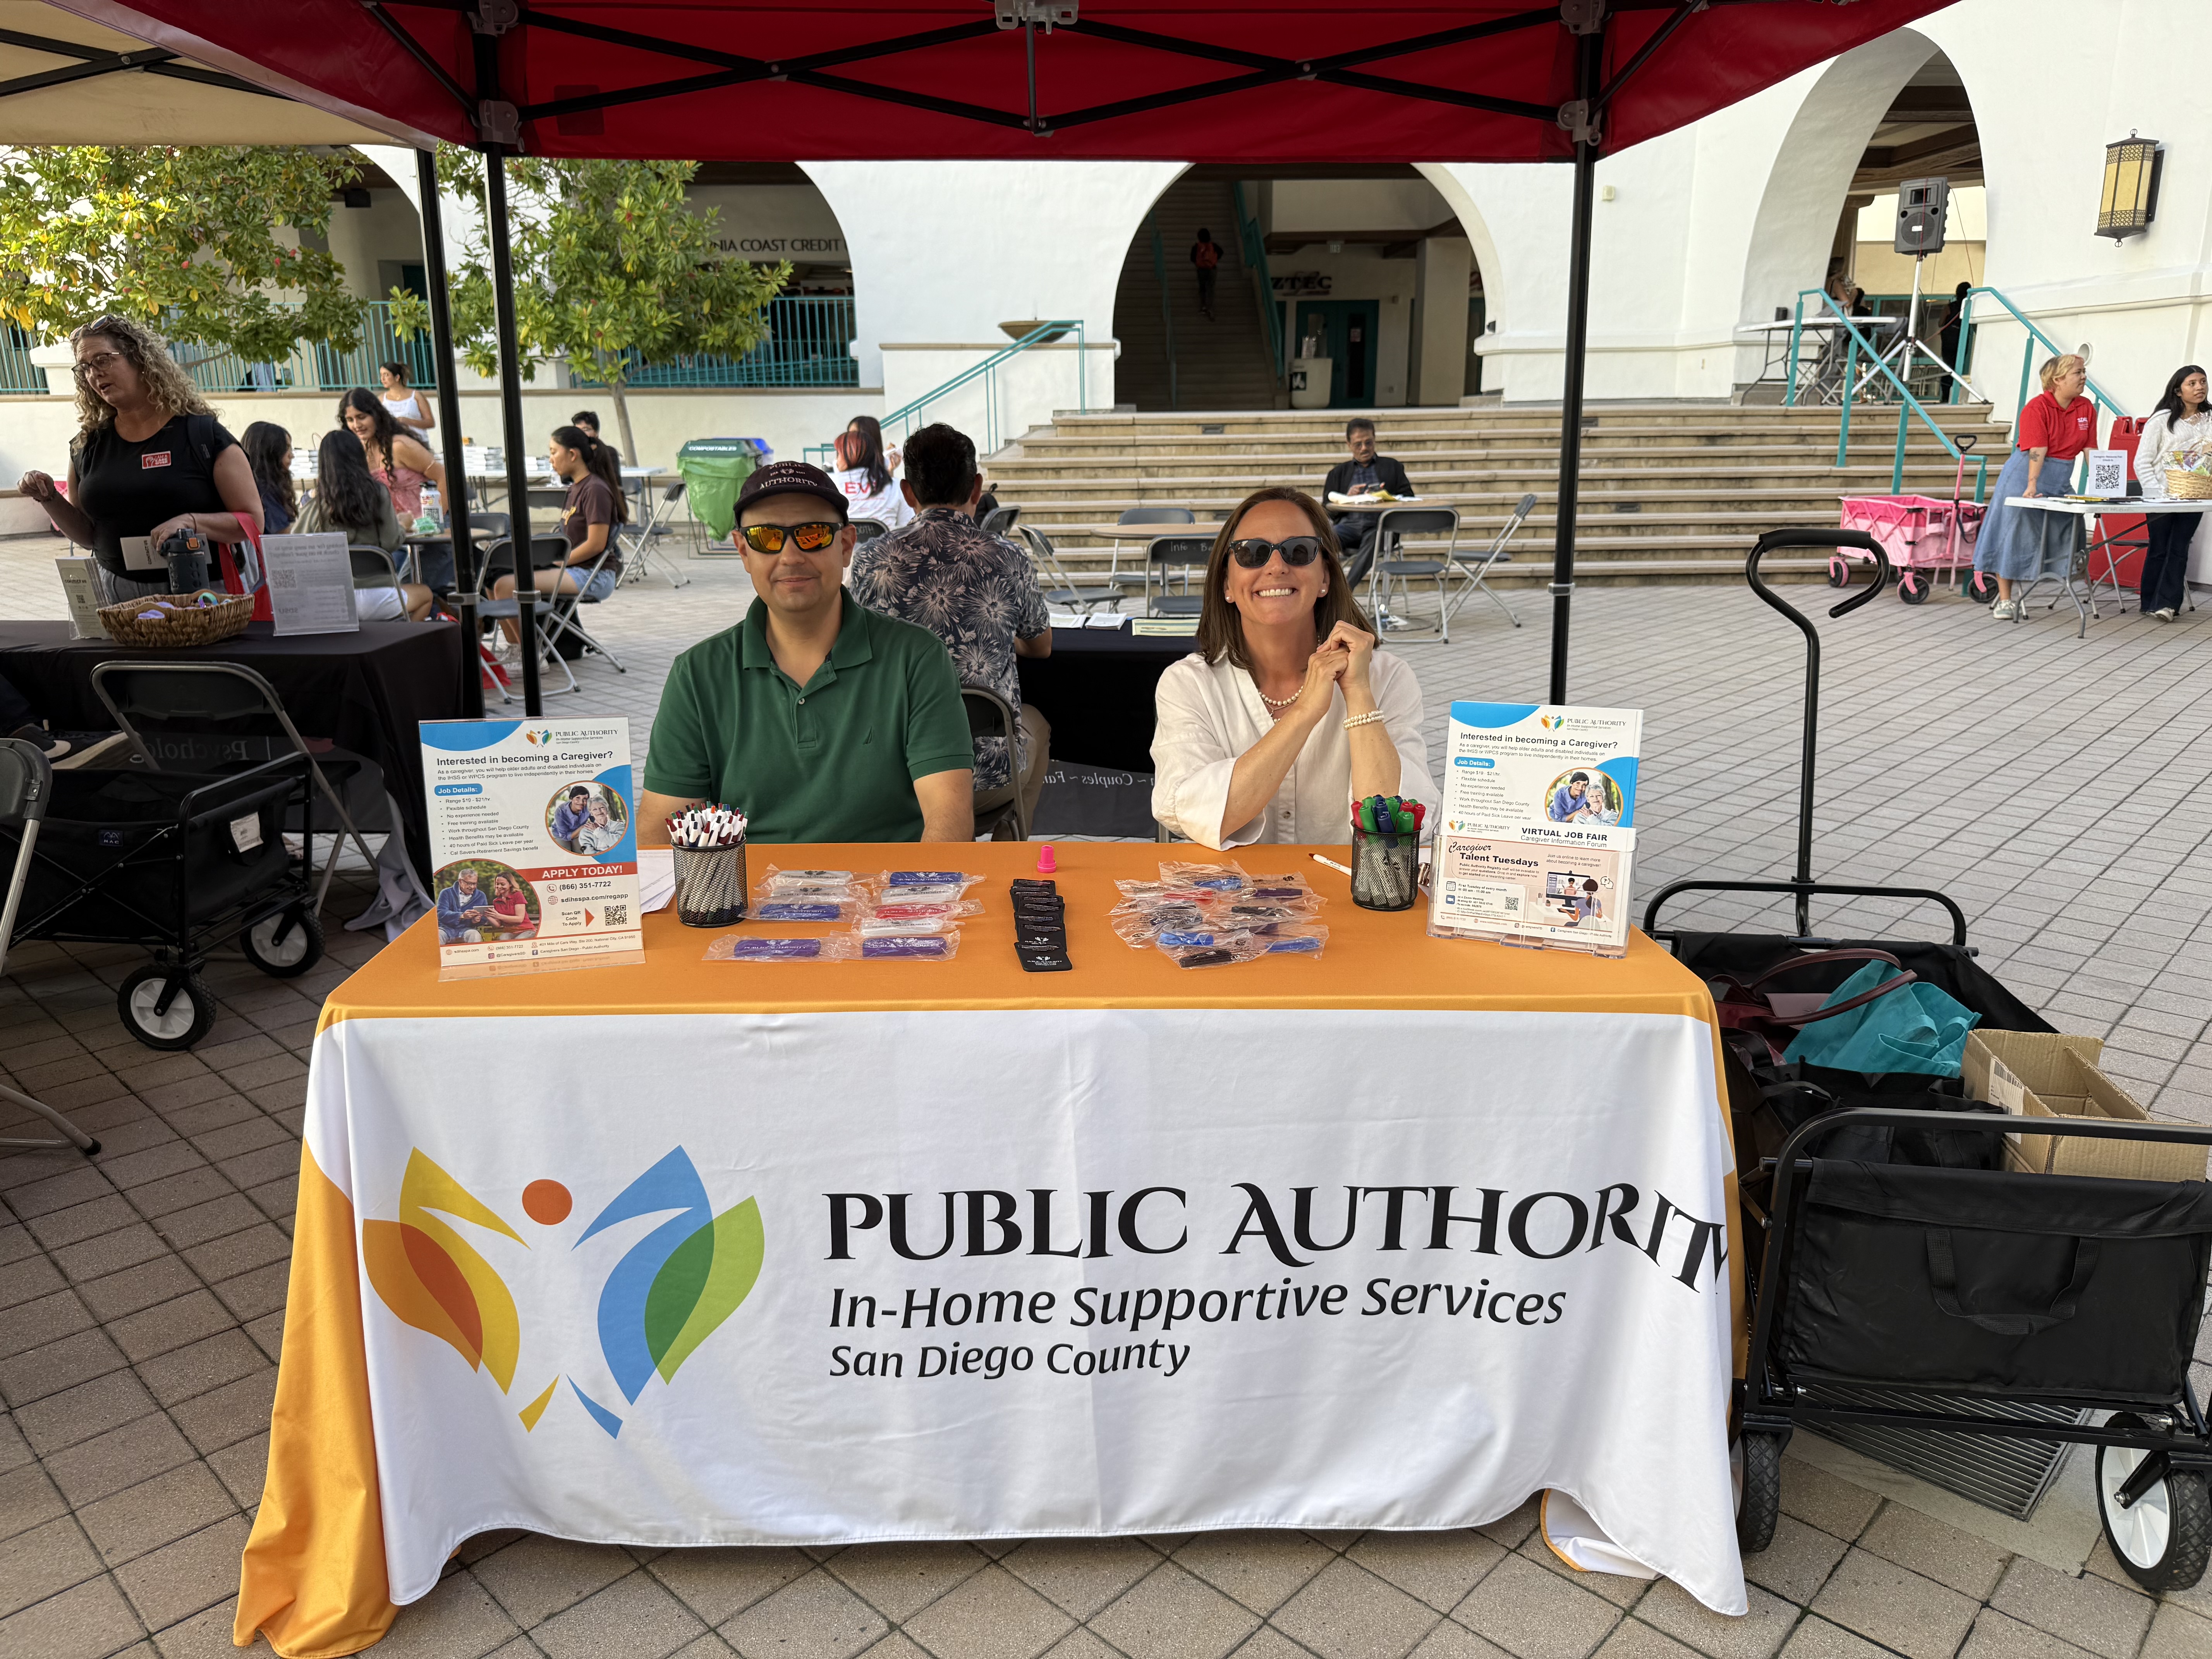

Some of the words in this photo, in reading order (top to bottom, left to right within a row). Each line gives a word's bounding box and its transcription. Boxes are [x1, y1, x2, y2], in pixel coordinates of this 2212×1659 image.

[712, 239, 738, 252] NIA
[740, 239, 788, 252] COAST
[791, 238, 841, 252] CREDIT
[1271, 276, 1332, 289] ZTEC
[760, 477, 817, 490] AUTHORITY
[1171, 541, 1188, 552] Info
[1461, 732, 1502, 741] Interested
[1515, 735, 1558, 746] becoming
[1569, 739, 1618, 749] Caregiver?
[437, 756, 486, 766] Interested
[501, 754, 549, 763] becoming
[561, 751, 613, 761] Caregiver?
[1522, 828, 1561, 837] VIRTUAL
[1449, 841, 1492, 854] Caregiver
[1460, 852, 1489, 862] Talent
[1492, 855, 1538, 867] Tuesdays
[542, 868, 579, 878] APPLY
[581, 865, 622, 876] TODAY!
[561, 894, 628, 902] sdihsspa.com/regapp
[821, 1187, 1188, 1260] PUBLIC
[830, 1287, 1055, 1328] In-Home
[1070, 1278, 1348, 1332] Supportive
[1361, 1278, 1566, 1325] Services
[830, 1345, 902, 1377] San
[918, 1341, 1033, 1379] Diego
[1047, 1339, 1190, 1377] County
